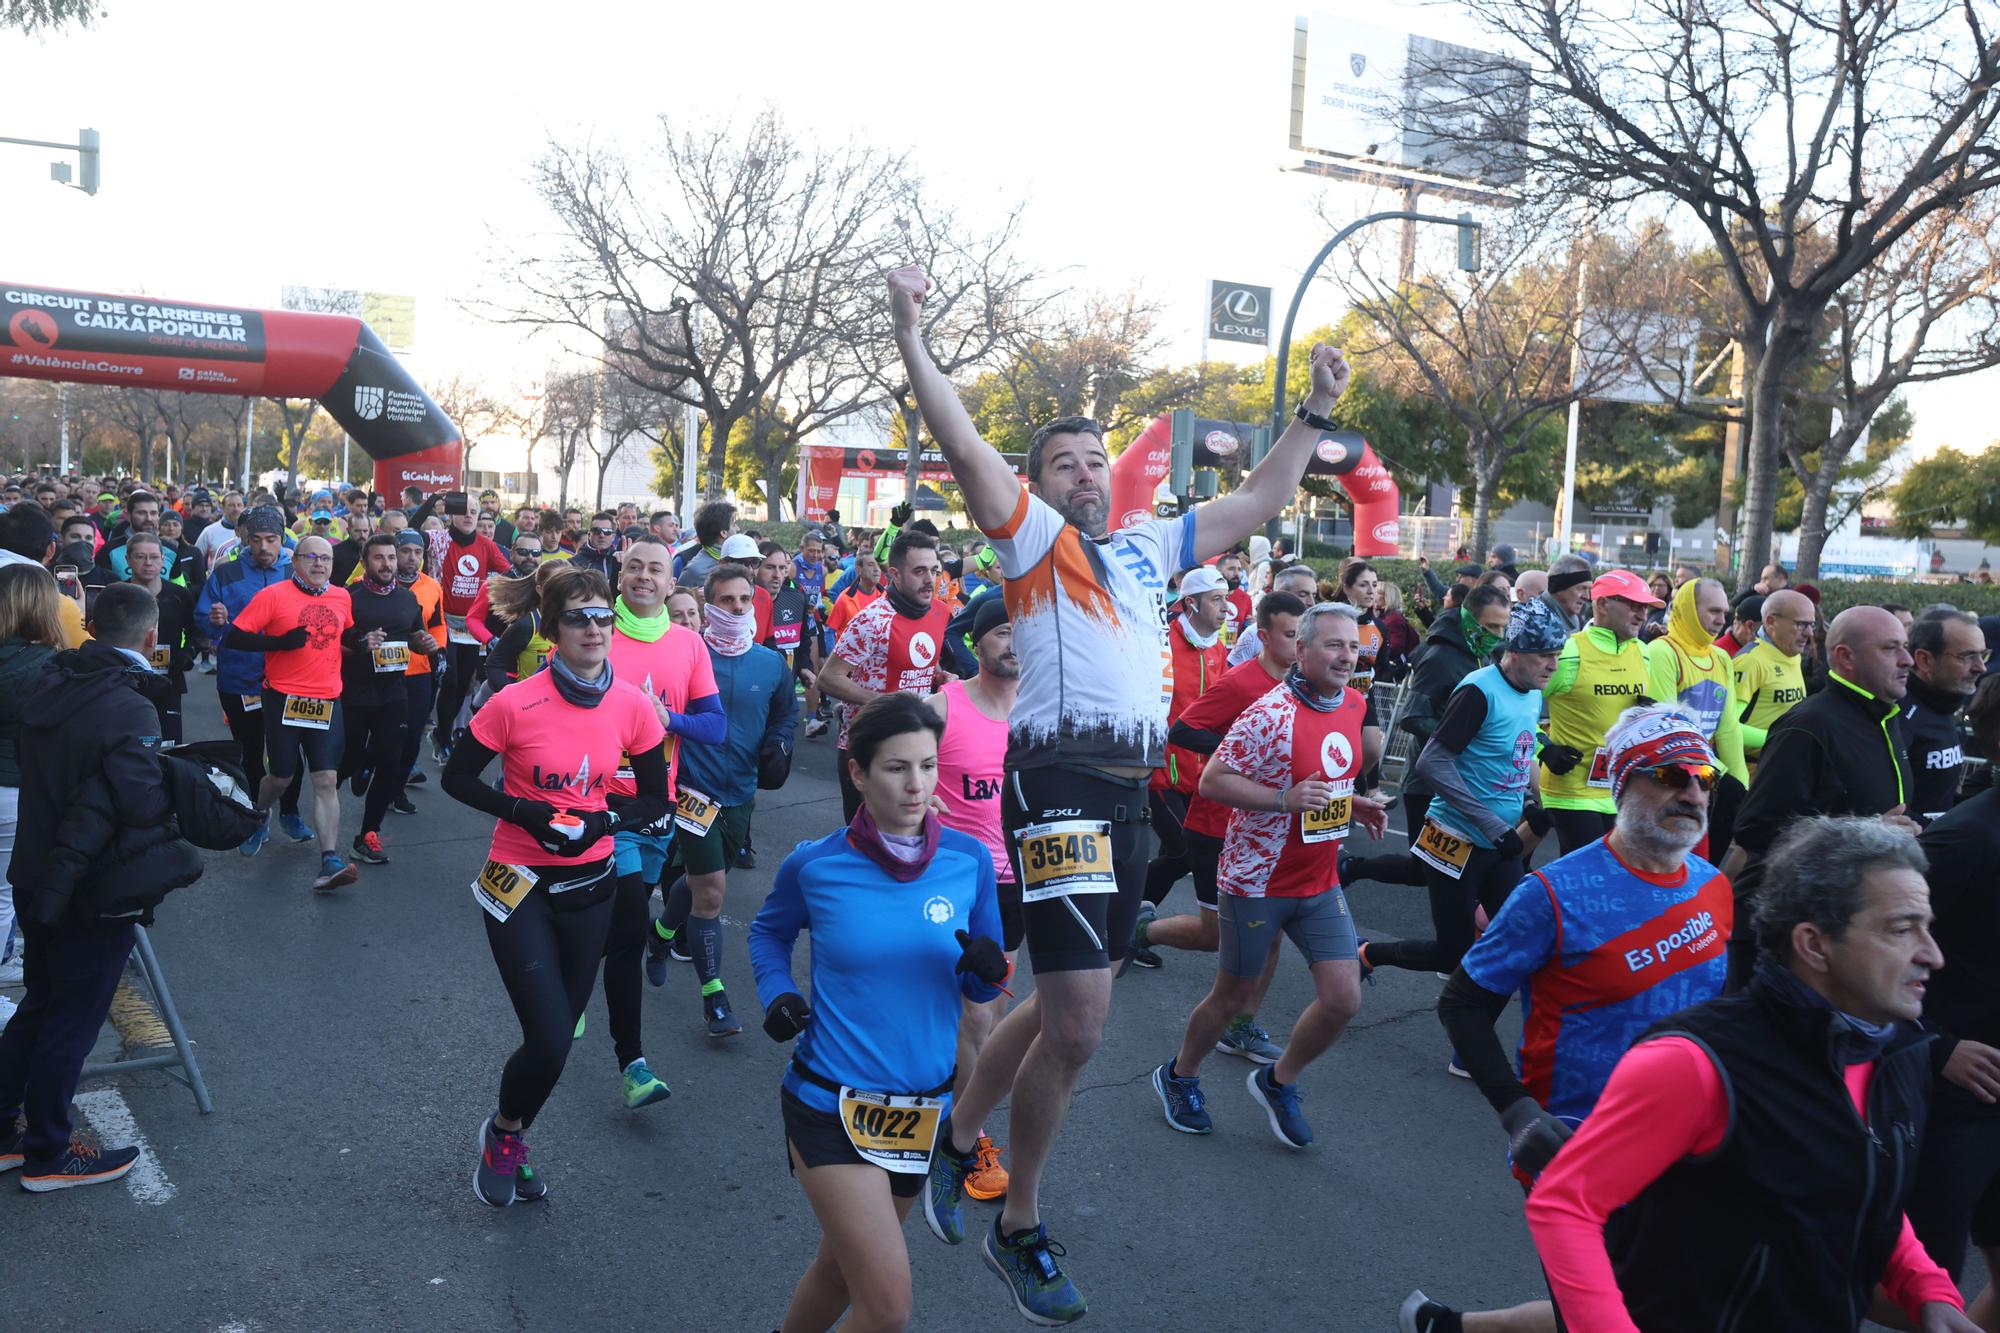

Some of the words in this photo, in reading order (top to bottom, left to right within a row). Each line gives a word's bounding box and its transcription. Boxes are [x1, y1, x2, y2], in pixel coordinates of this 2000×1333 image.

[5, 290, 92, 311] CIRCUIT
[97, 301, 127, 315] DE
[130, 304, 243, 326] CARRERES
[74, 311, 147, 333] CAIXA
[148, 318, 246, 342] POPULAR
[1214, 323, 1266, 338] LEXUS
[10, 353, 144, 375] #ValènciaCorre
[387, 406, 427, 417] Municipal
[899, 676, 933, 689] CARRERES
[900, 668, 926, 680] CIRCUIT
[290, 700, 325, 716] 4058
[1042, 808, 1082, 818] 2XU
[1029, 834, 1098, 870] 3546
[1427, 826, 1460, 858] 3412
[1624, 947, 1656, 973] Es
[1654, 911, 1714, 963] posible
[852, 1104, 921, 1139] 4022
